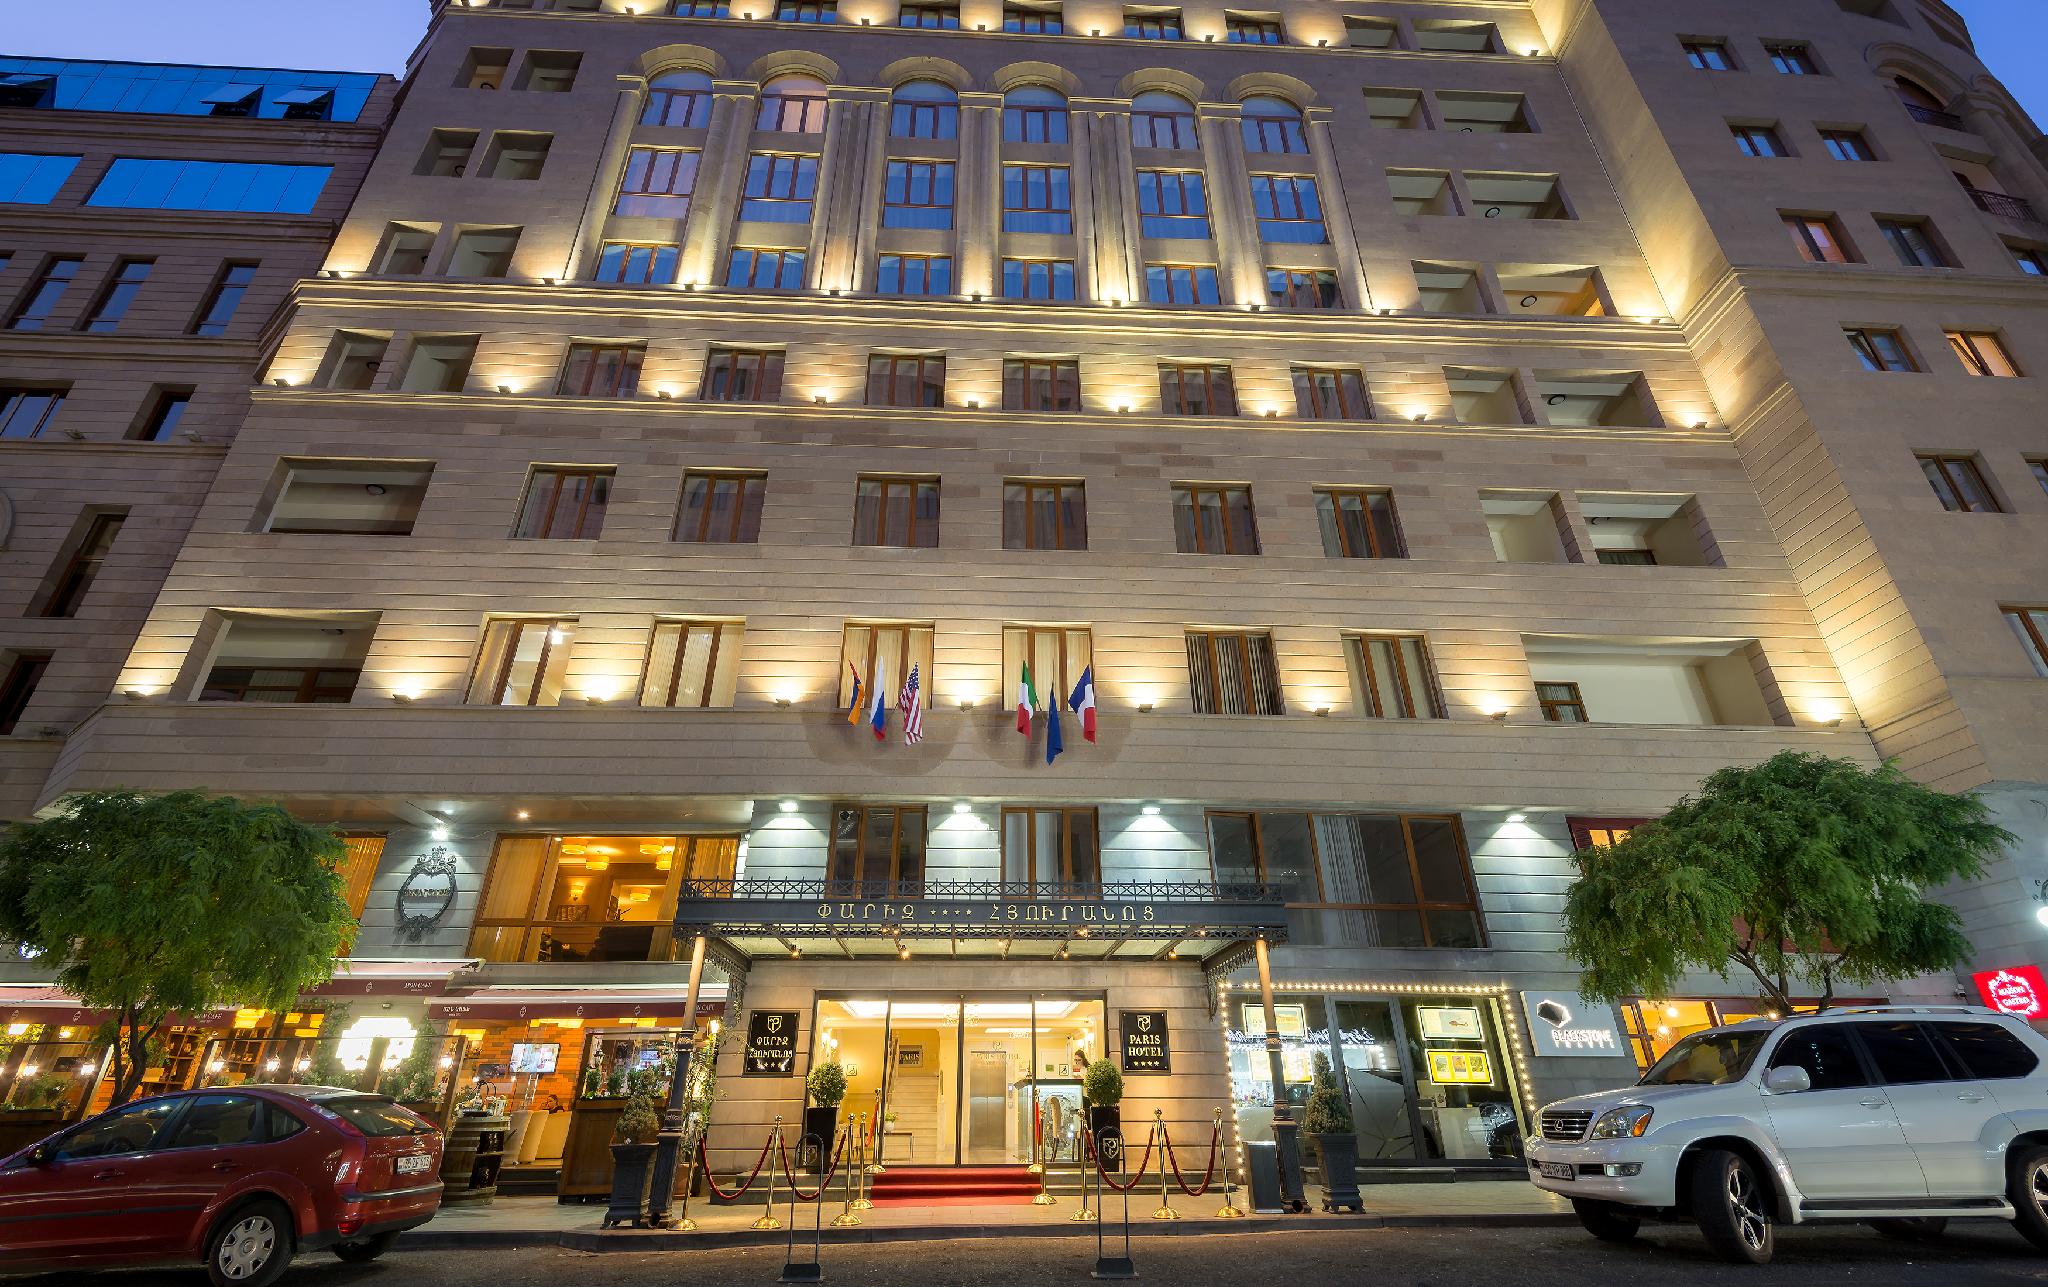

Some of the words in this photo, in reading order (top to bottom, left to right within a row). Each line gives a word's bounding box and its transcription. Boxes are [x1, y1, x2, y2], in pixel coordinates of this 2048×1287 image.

[1129, 1034, 1161, 1045] PARIS
[1552, 1029, 1611, 1042] BLACKSTONE
[1128, 1046, 1164, 1057] HOTEL
